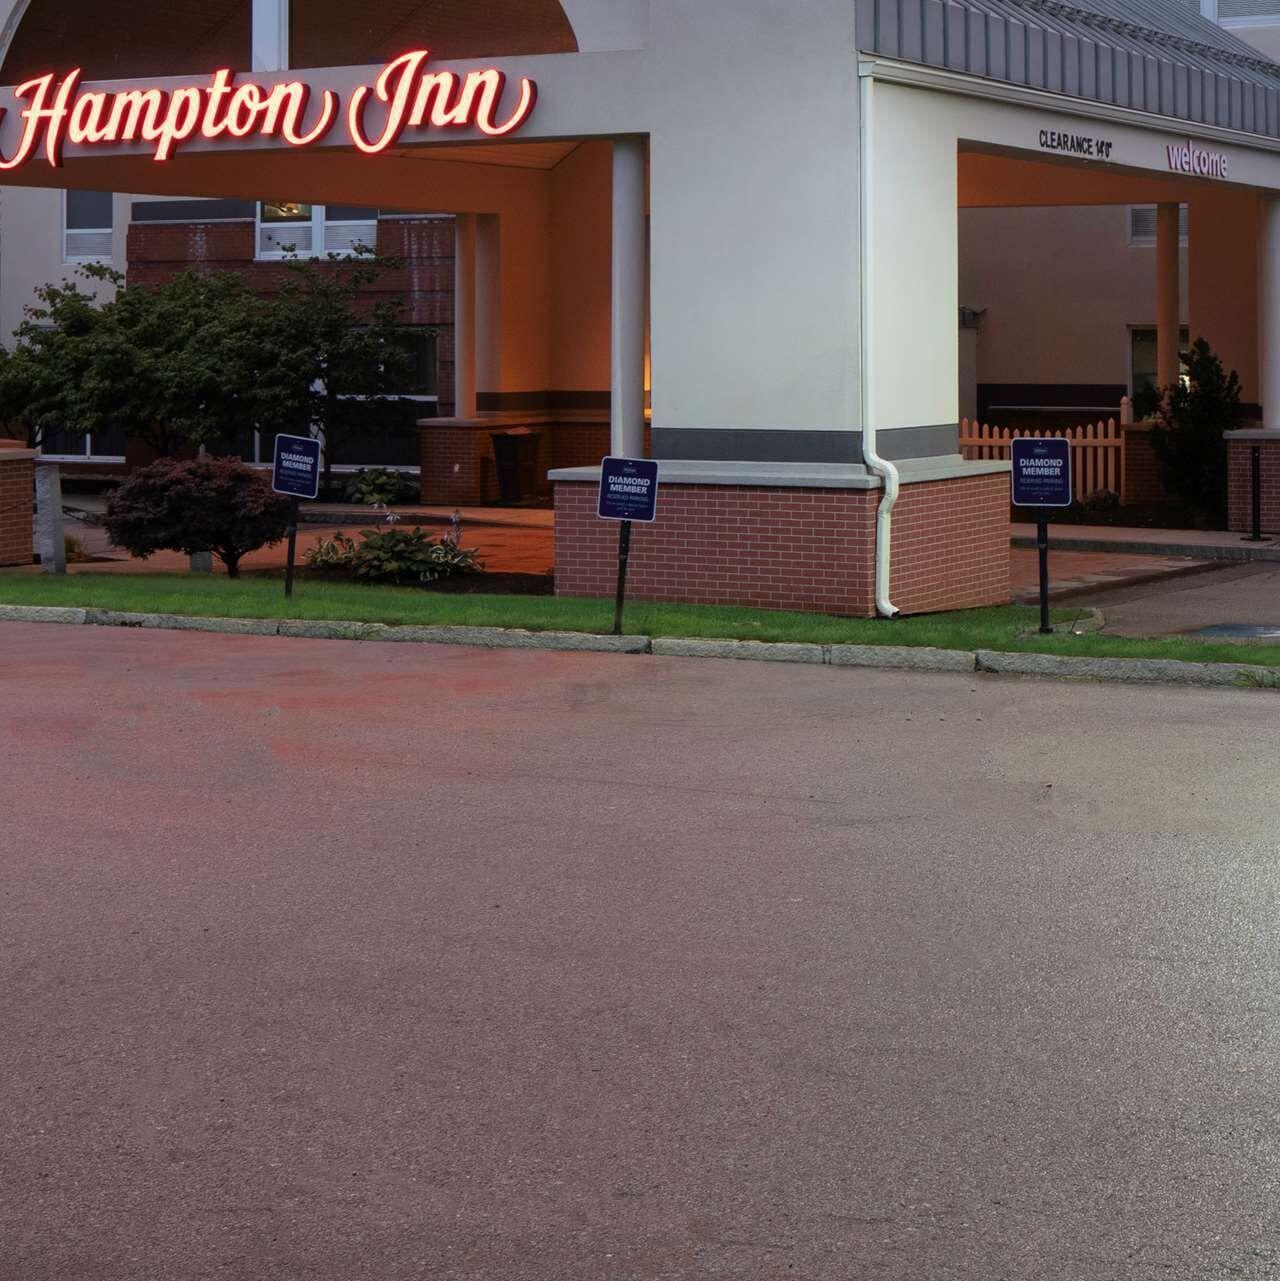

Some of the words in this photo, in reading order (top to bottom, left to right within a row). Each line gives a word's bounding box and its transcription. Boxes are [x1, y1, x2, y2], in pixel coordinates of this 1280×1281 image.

[348, 48, 538, 154] Inn
[1039, 129, 1093, 156] CLEARANCE
[1167, 139, 1228, 178] welcome
[280, 451, 314, 464] DIAMOND
[1019, 458, 1063, 467] DIAMOND
[1022, 467, 1061, 476] MEMBER
[608, 475, 651, 486] DIAMOND
[609, 484, 648, 495] MEMBER
